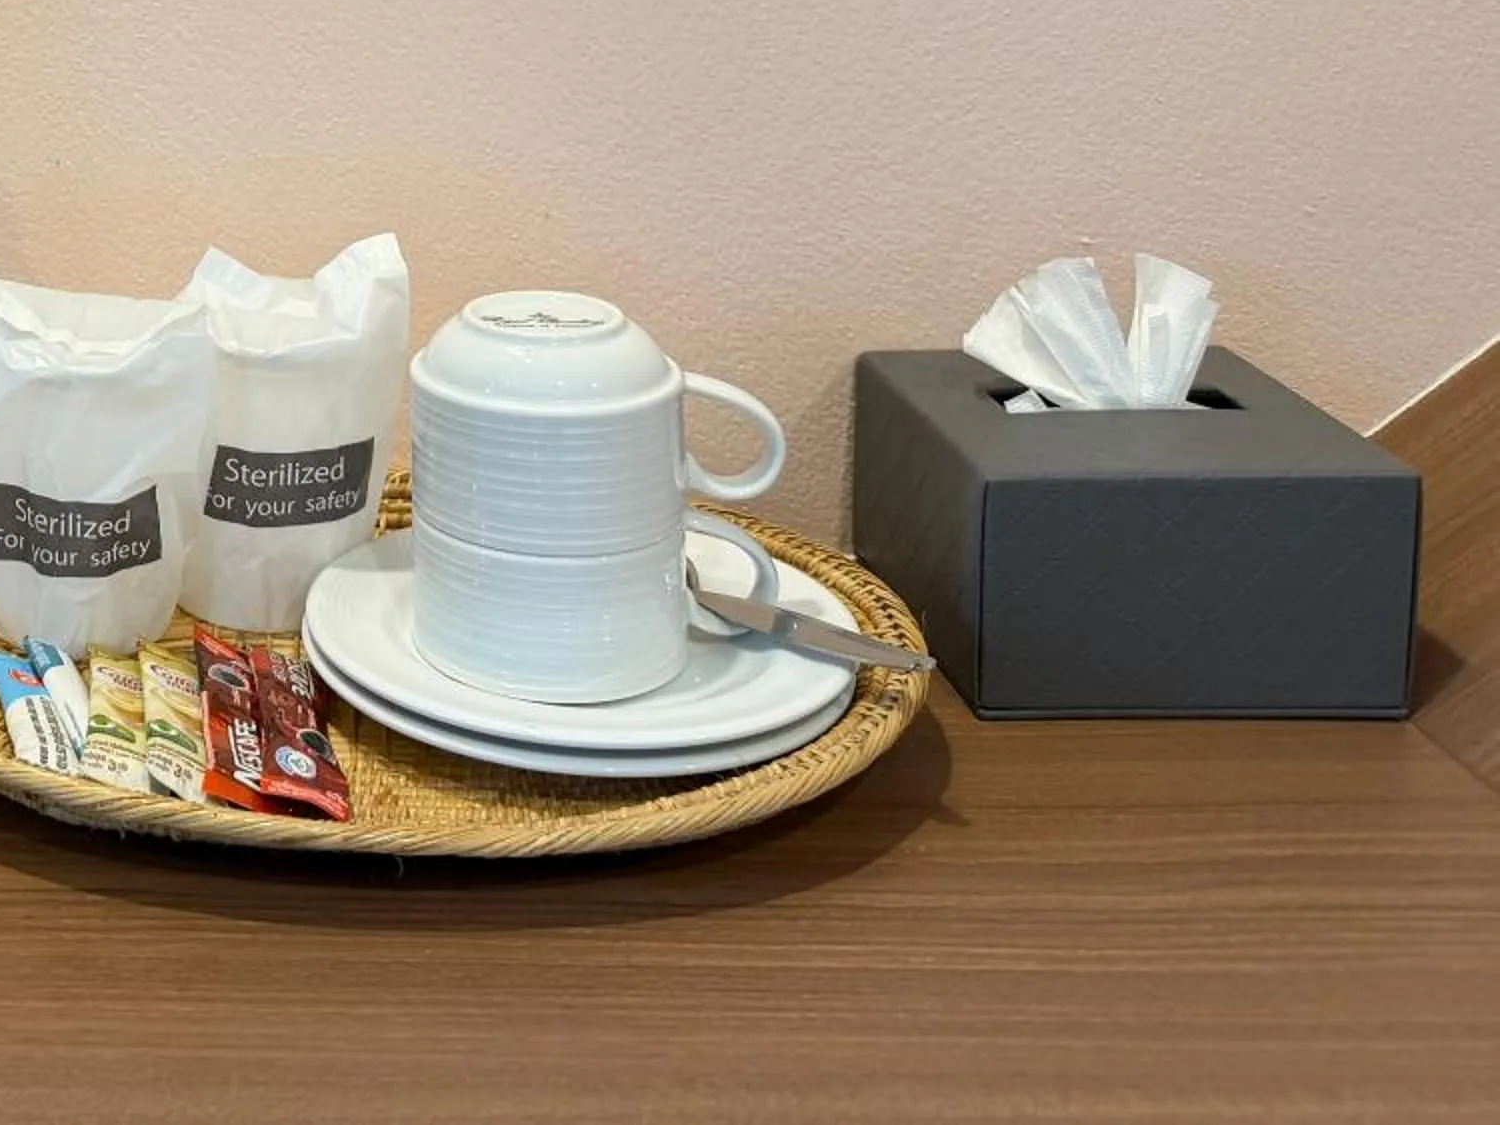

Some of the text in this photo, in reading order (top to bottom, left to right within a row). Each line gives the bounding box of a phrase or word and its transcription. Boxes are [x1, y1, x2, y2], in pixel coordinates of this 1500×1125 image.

[223, 455, 346, 488] Sterilized
[14, 497, 131, 540] Sterilized
[245, 498, 296, 520] your
[305, 486, 361, 514] safety
[31, 542, 79, 567] your
[90, 538, 151, 568] safety
